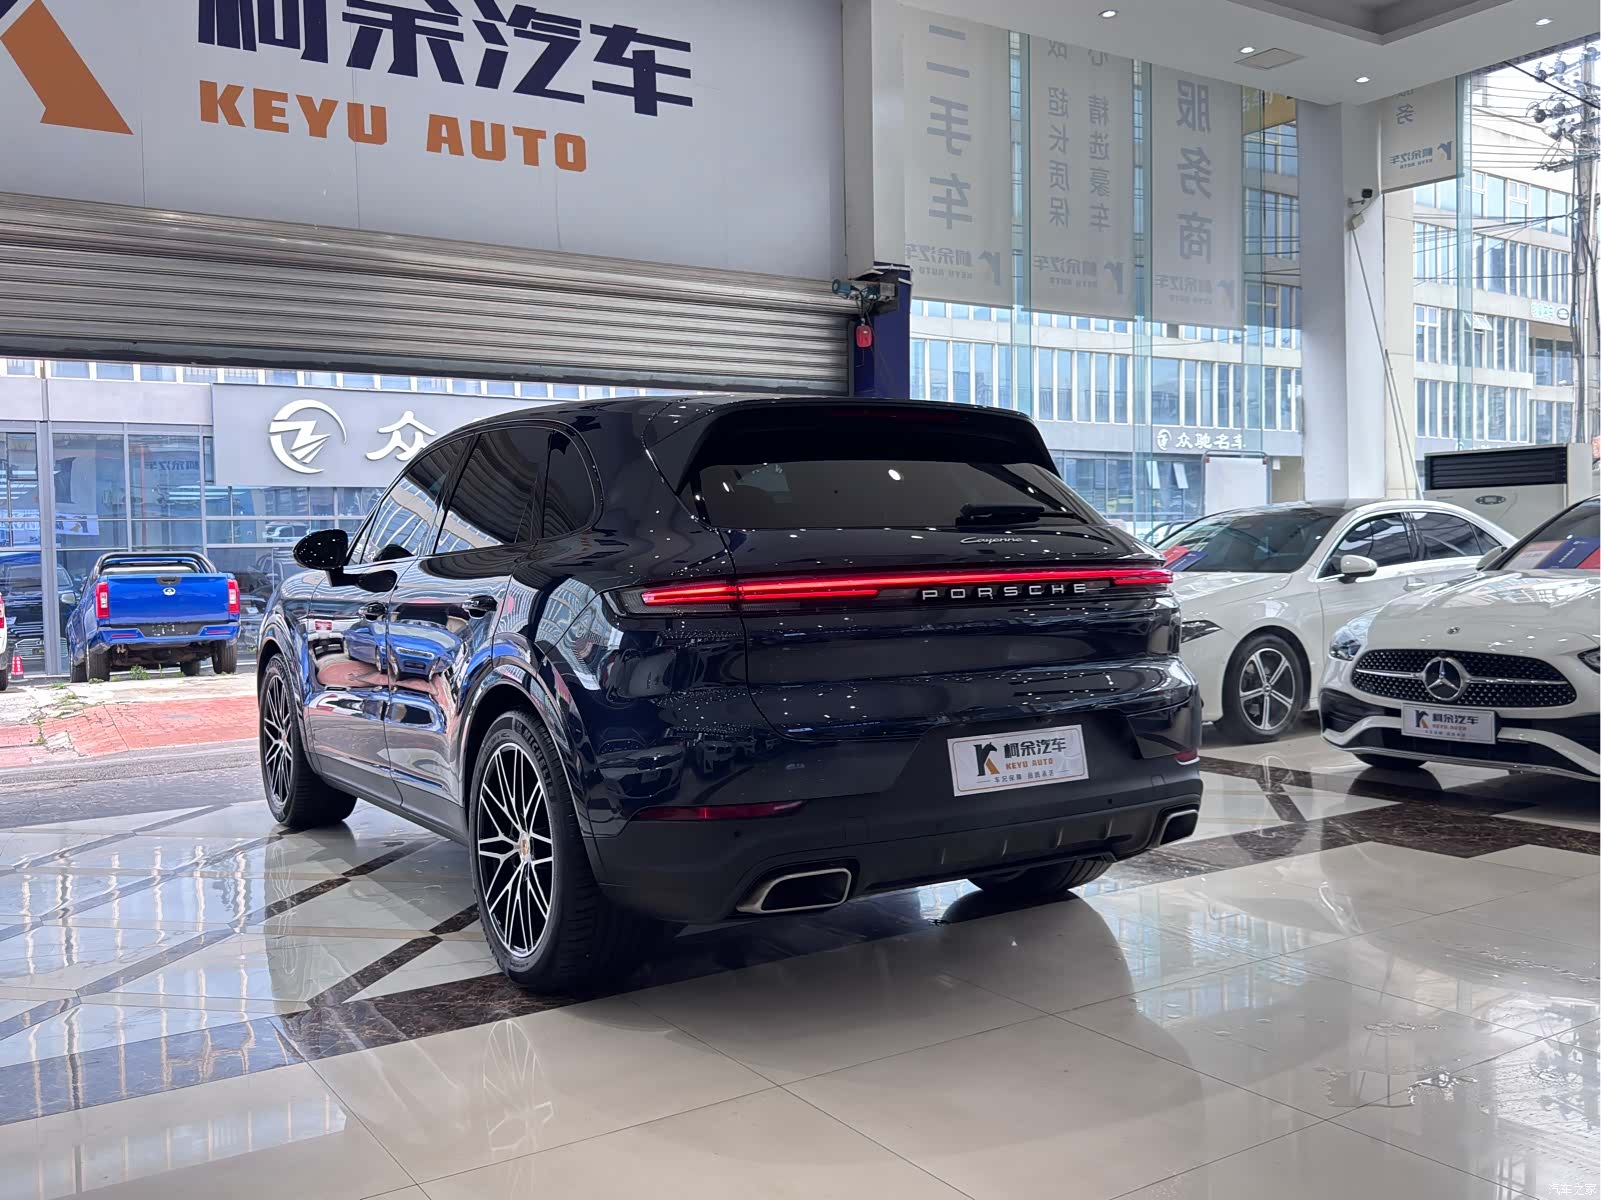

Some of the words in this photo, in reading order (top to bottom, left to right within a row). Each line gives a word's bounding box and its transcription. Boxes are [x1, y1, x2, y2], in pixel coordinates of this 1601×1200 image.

[199, 80, 388, 146] KEYU
[426, 114, 587, 173] AUTO
[960, 535, 1024, 545] Cayenne
[922, 583, 1086, 600] PORSCHE
[1003, 737, 1067, 759] 柯余汽车
[1005, 760, 1029, 771] KEYU
[1032, 757, 1054, 767] AUTO
